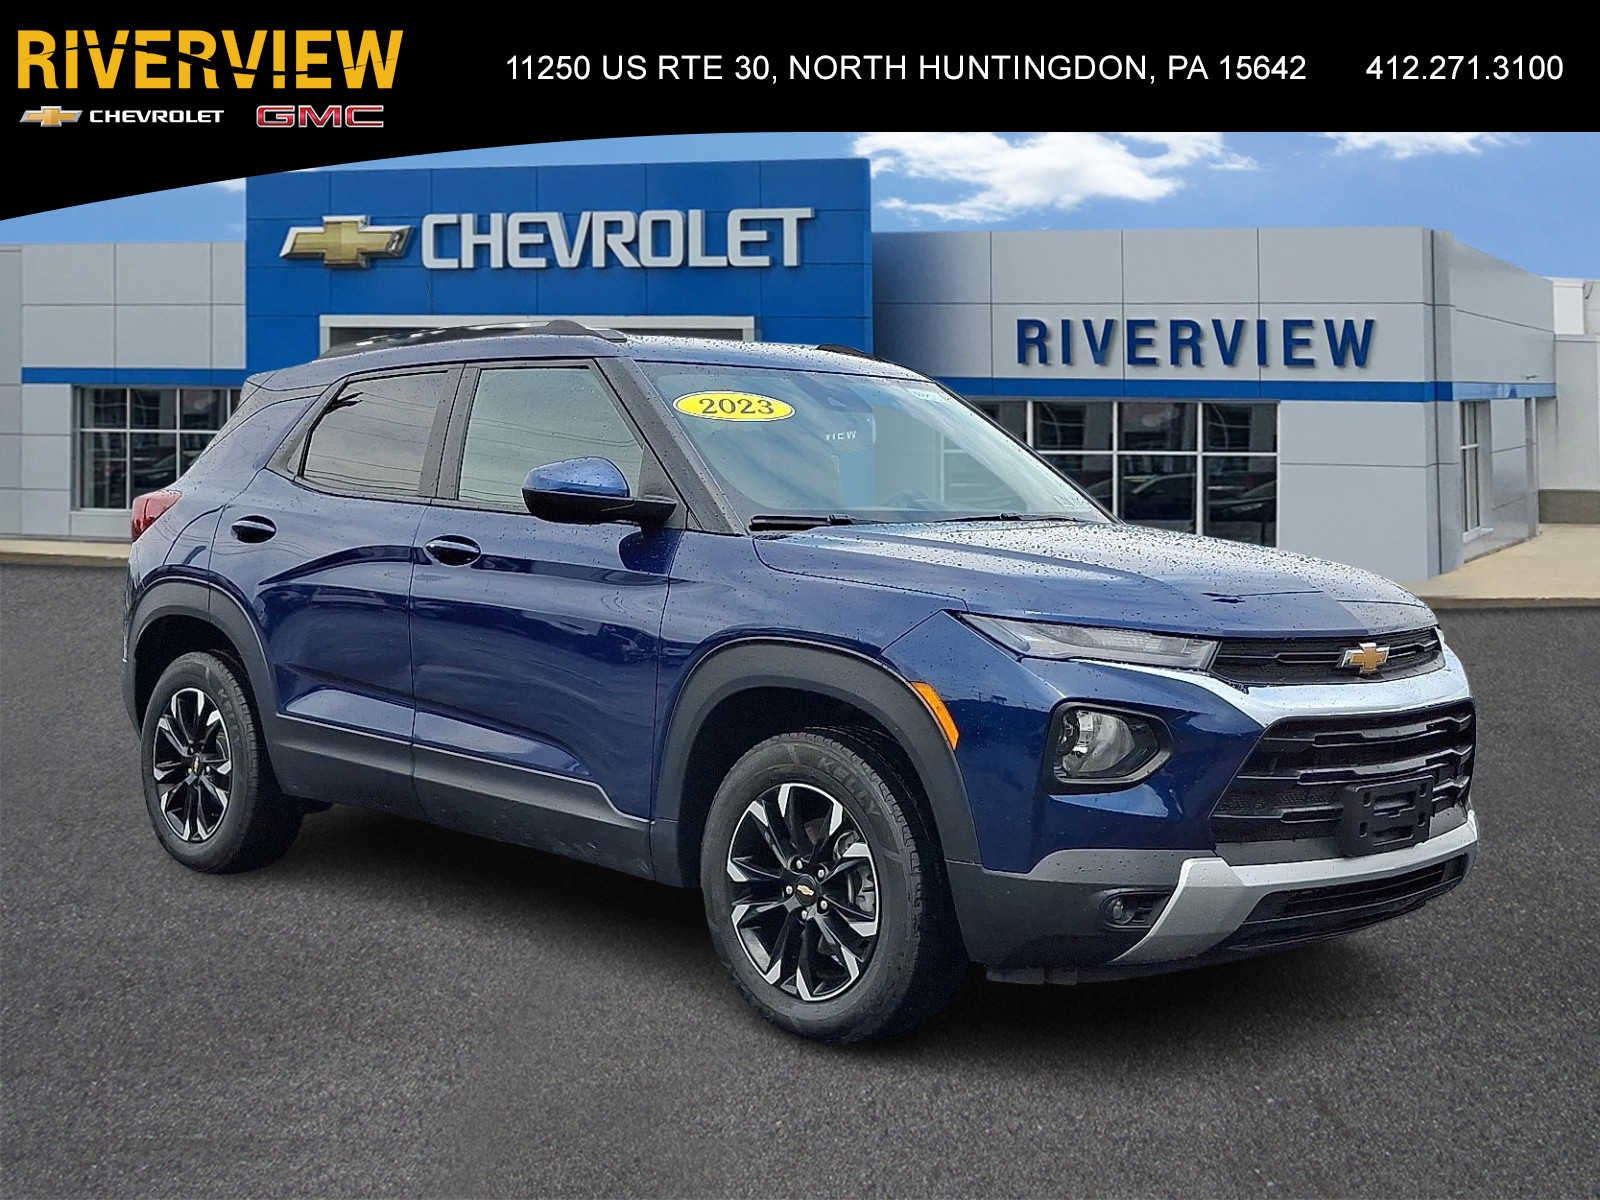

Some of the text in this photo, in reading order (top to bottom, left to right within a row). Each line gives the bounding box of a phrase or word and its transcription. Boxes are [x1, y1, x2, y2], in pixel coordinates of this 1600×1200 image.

[421, 207, 815, 270] CHEVROLET
[1016, 318, 1376, 368] RIVERVIEW
[699, 398, 775, 414] 2023
